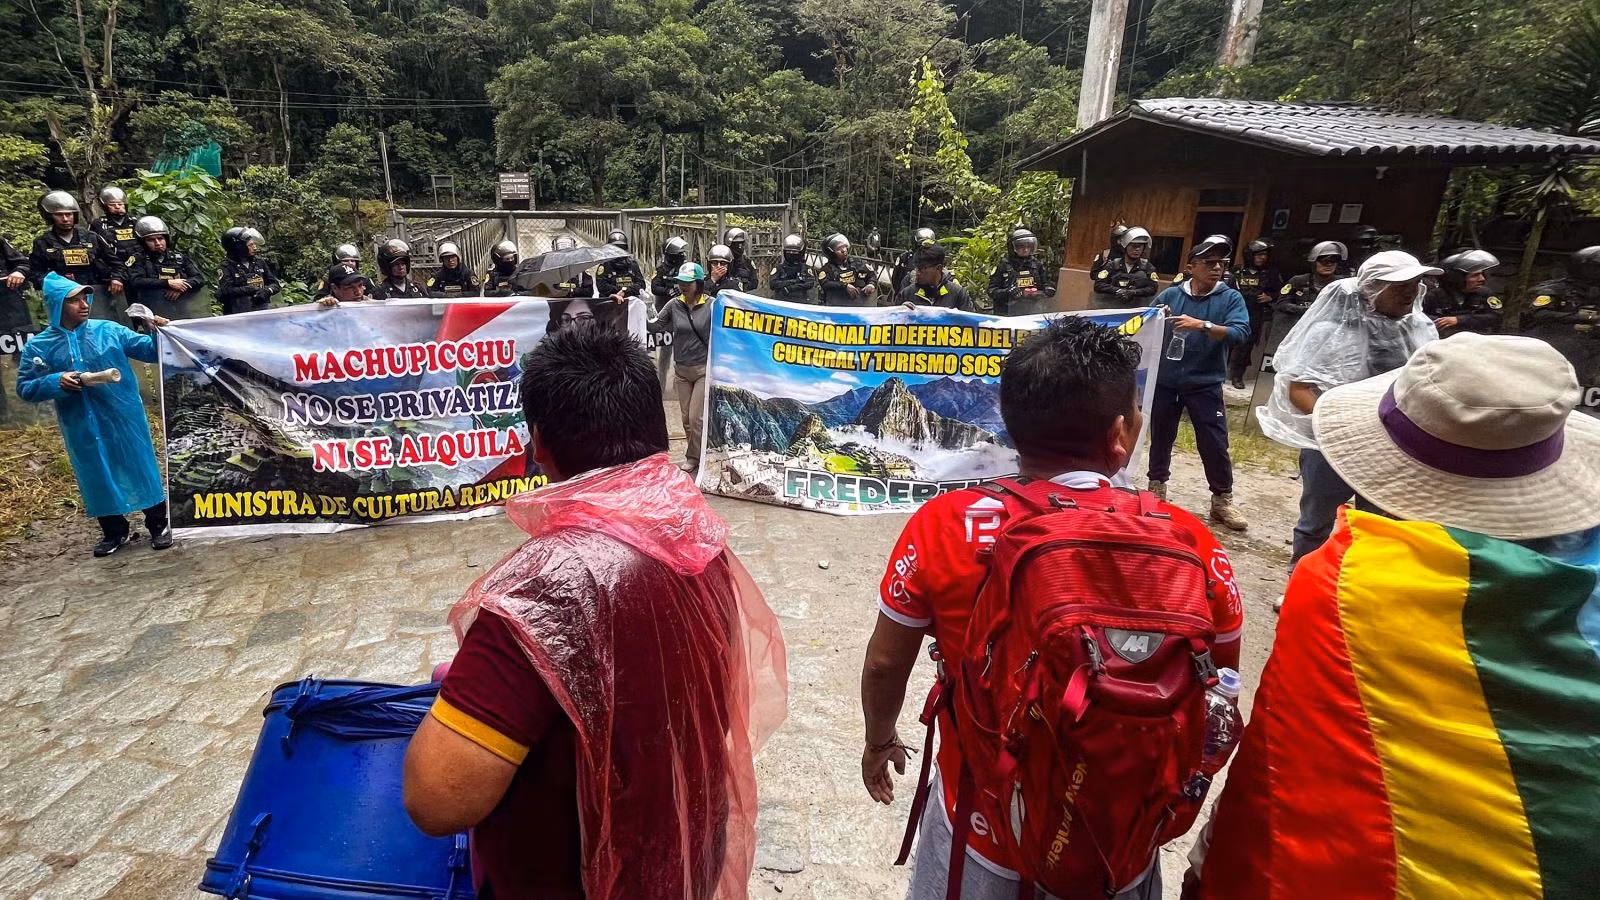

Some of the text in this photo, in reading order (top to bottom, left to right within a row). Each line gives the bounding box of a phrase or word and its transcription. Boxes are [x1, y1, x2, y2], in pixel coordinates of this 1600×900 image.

[723, 306, 784, 335] FRENTE
[786, 317, 866, 345] REGIONAL
[869, 325, 891, 345] DE
[895, 326, 973, 347] DEFENSA
[978, 328, 1012, 348] DEL
[291, 339, 516, 383] MACHUPICCHU
[773, 342, 1006, 377] CULTURAL Y TURISMO SOS
[283, 392, 332, 425] NO
[336, 394, 375, 423] SE
[312, 427, 525, 472] NI SE ALQUILA
[193, 490, 316, 519] MINISTRA
[318, 494, 350, 515] DE
[353, 489, 456, 519] CULTURA
